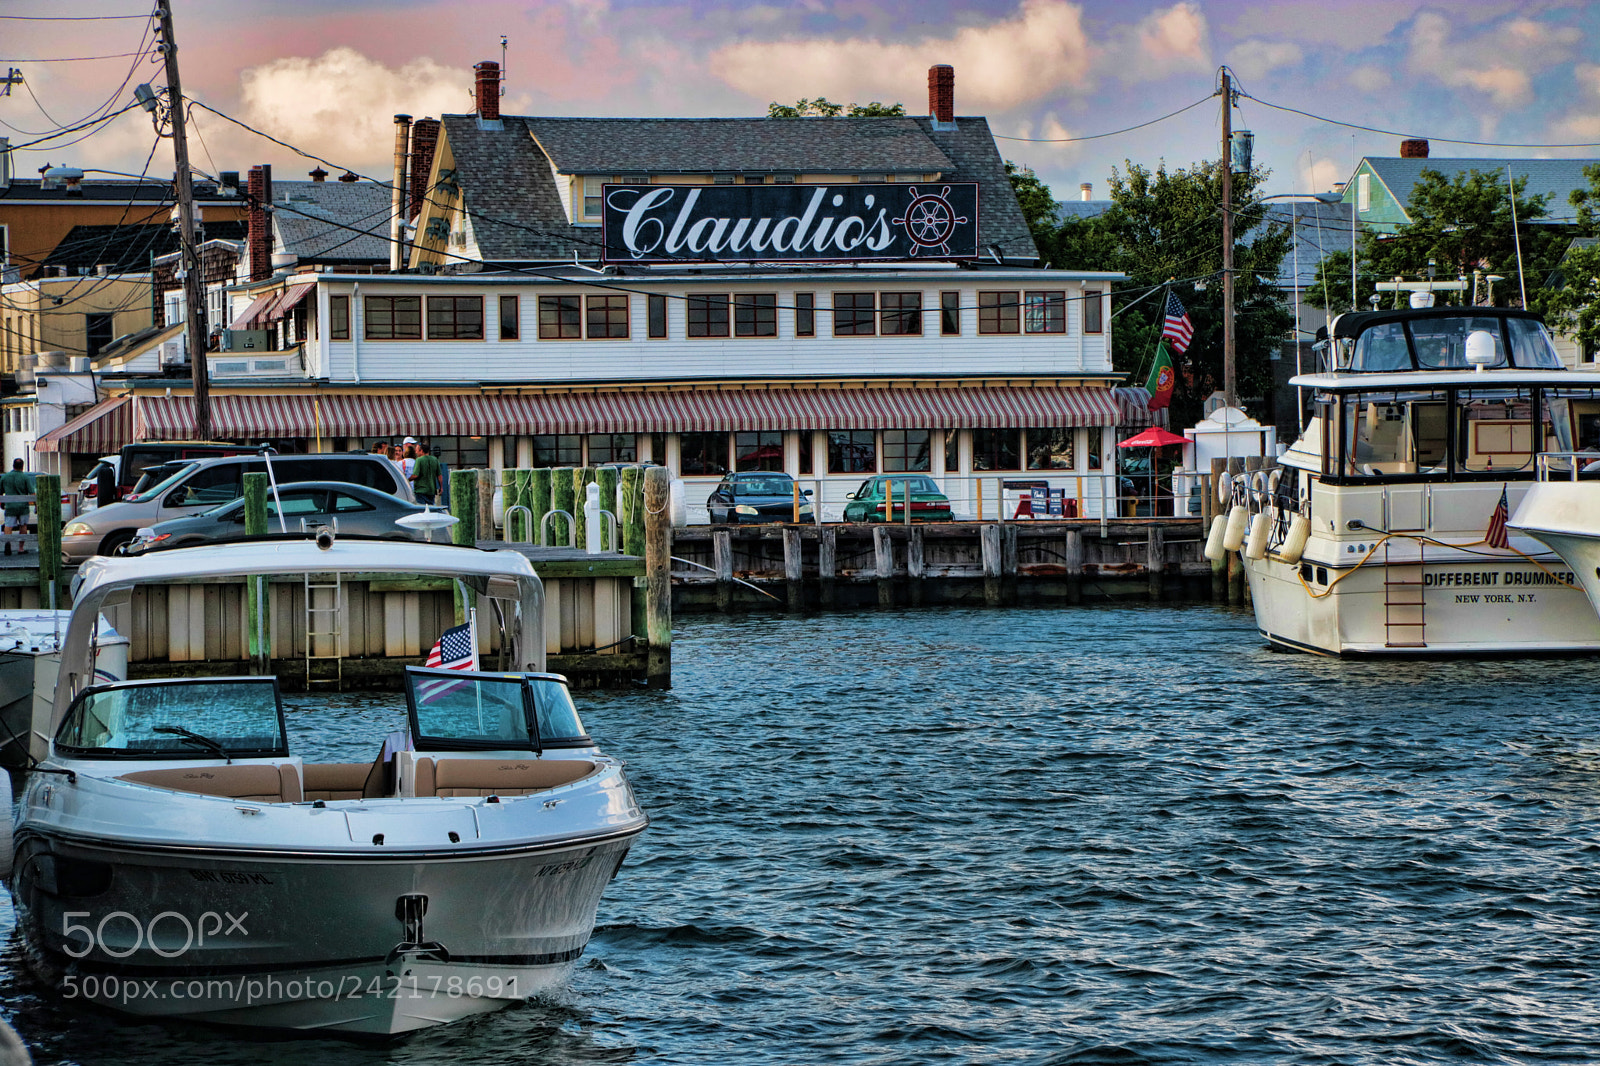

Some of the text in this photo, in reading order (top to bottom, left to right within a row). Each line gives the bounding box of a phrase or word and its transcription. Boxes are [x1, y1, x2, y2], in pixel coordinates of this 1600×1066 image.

[606, 186, 896, 259] Claudio's
[1424, 571, 1575, 586] DIFFERENT DRUMMER
[1455, 594, 1537, 603] NEW YORK, N.Y.
